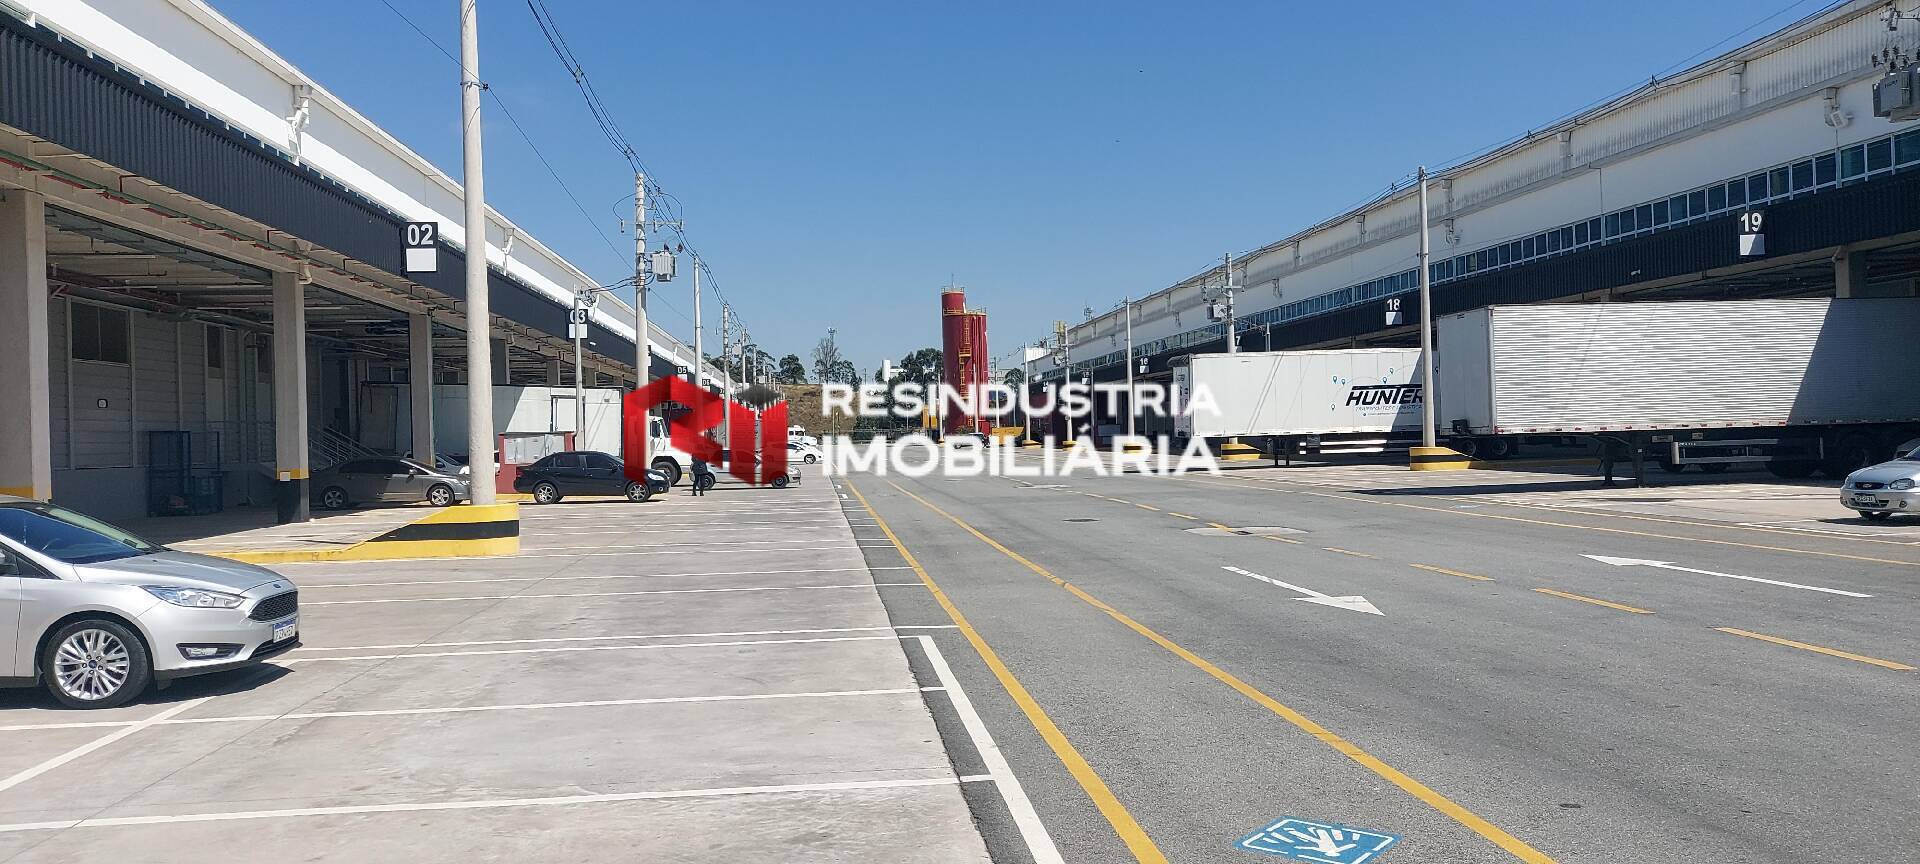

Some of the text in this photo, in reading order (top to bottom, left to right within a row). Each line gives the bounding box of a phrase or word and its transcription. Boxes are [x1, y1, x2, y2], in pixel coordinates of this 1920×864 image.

[1740, 212, 1763, 232] 19
[407, 223, 434, 246] 02
[1386, 298, 1401, 311] 18
